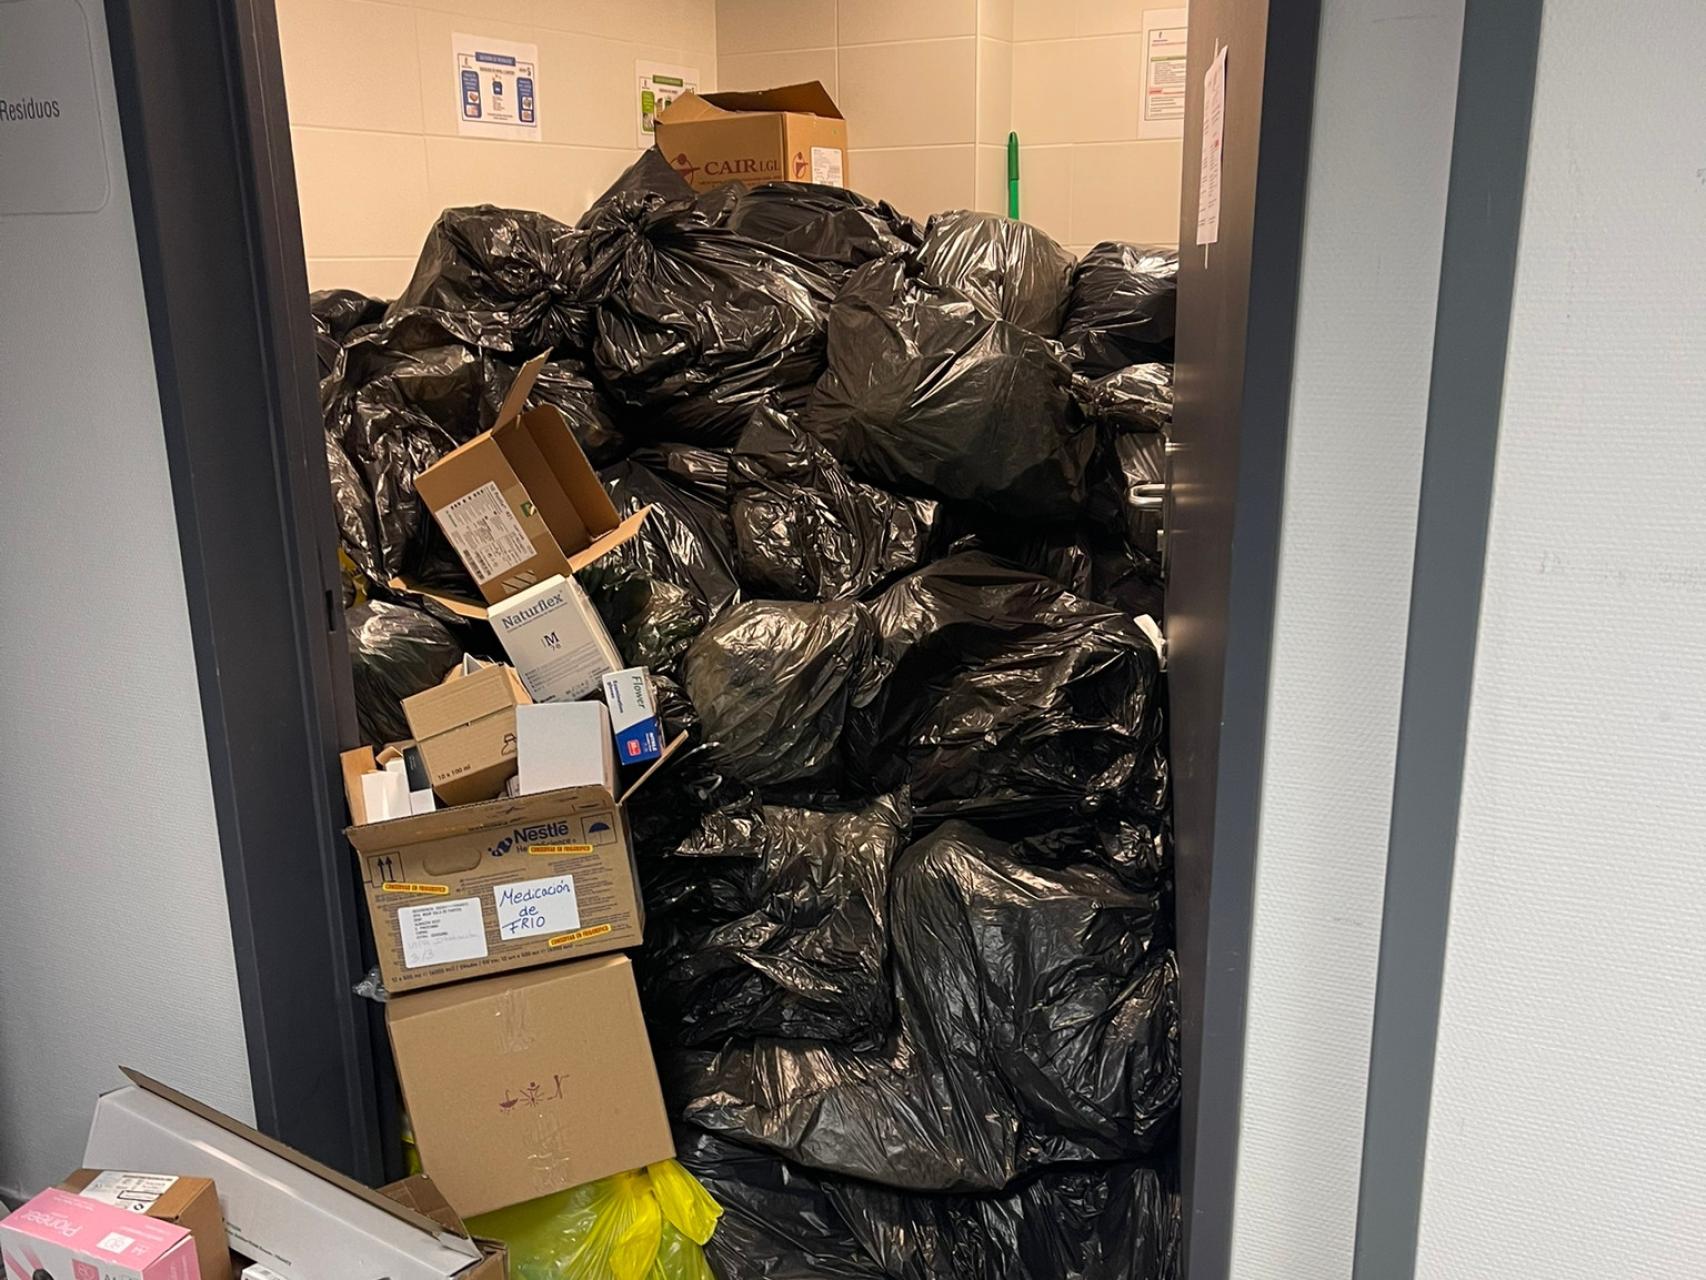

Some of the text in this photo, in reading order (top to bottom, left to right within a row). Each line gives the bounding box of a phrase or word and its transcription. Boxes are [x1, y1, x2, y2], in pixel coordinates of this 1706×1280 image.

[0, 98, 60, 121] Residuos
[704, 159, 758, 176] CAIR
[501, 593, 563, 629] Naturflex
[545, 632, 560, 647] M
[632, 675, 645, 709] Flower
[513, 820, 569, 843] Nestlé
[500, 880, 571, 906] Medicación
[519, 904, 539, 917] de
